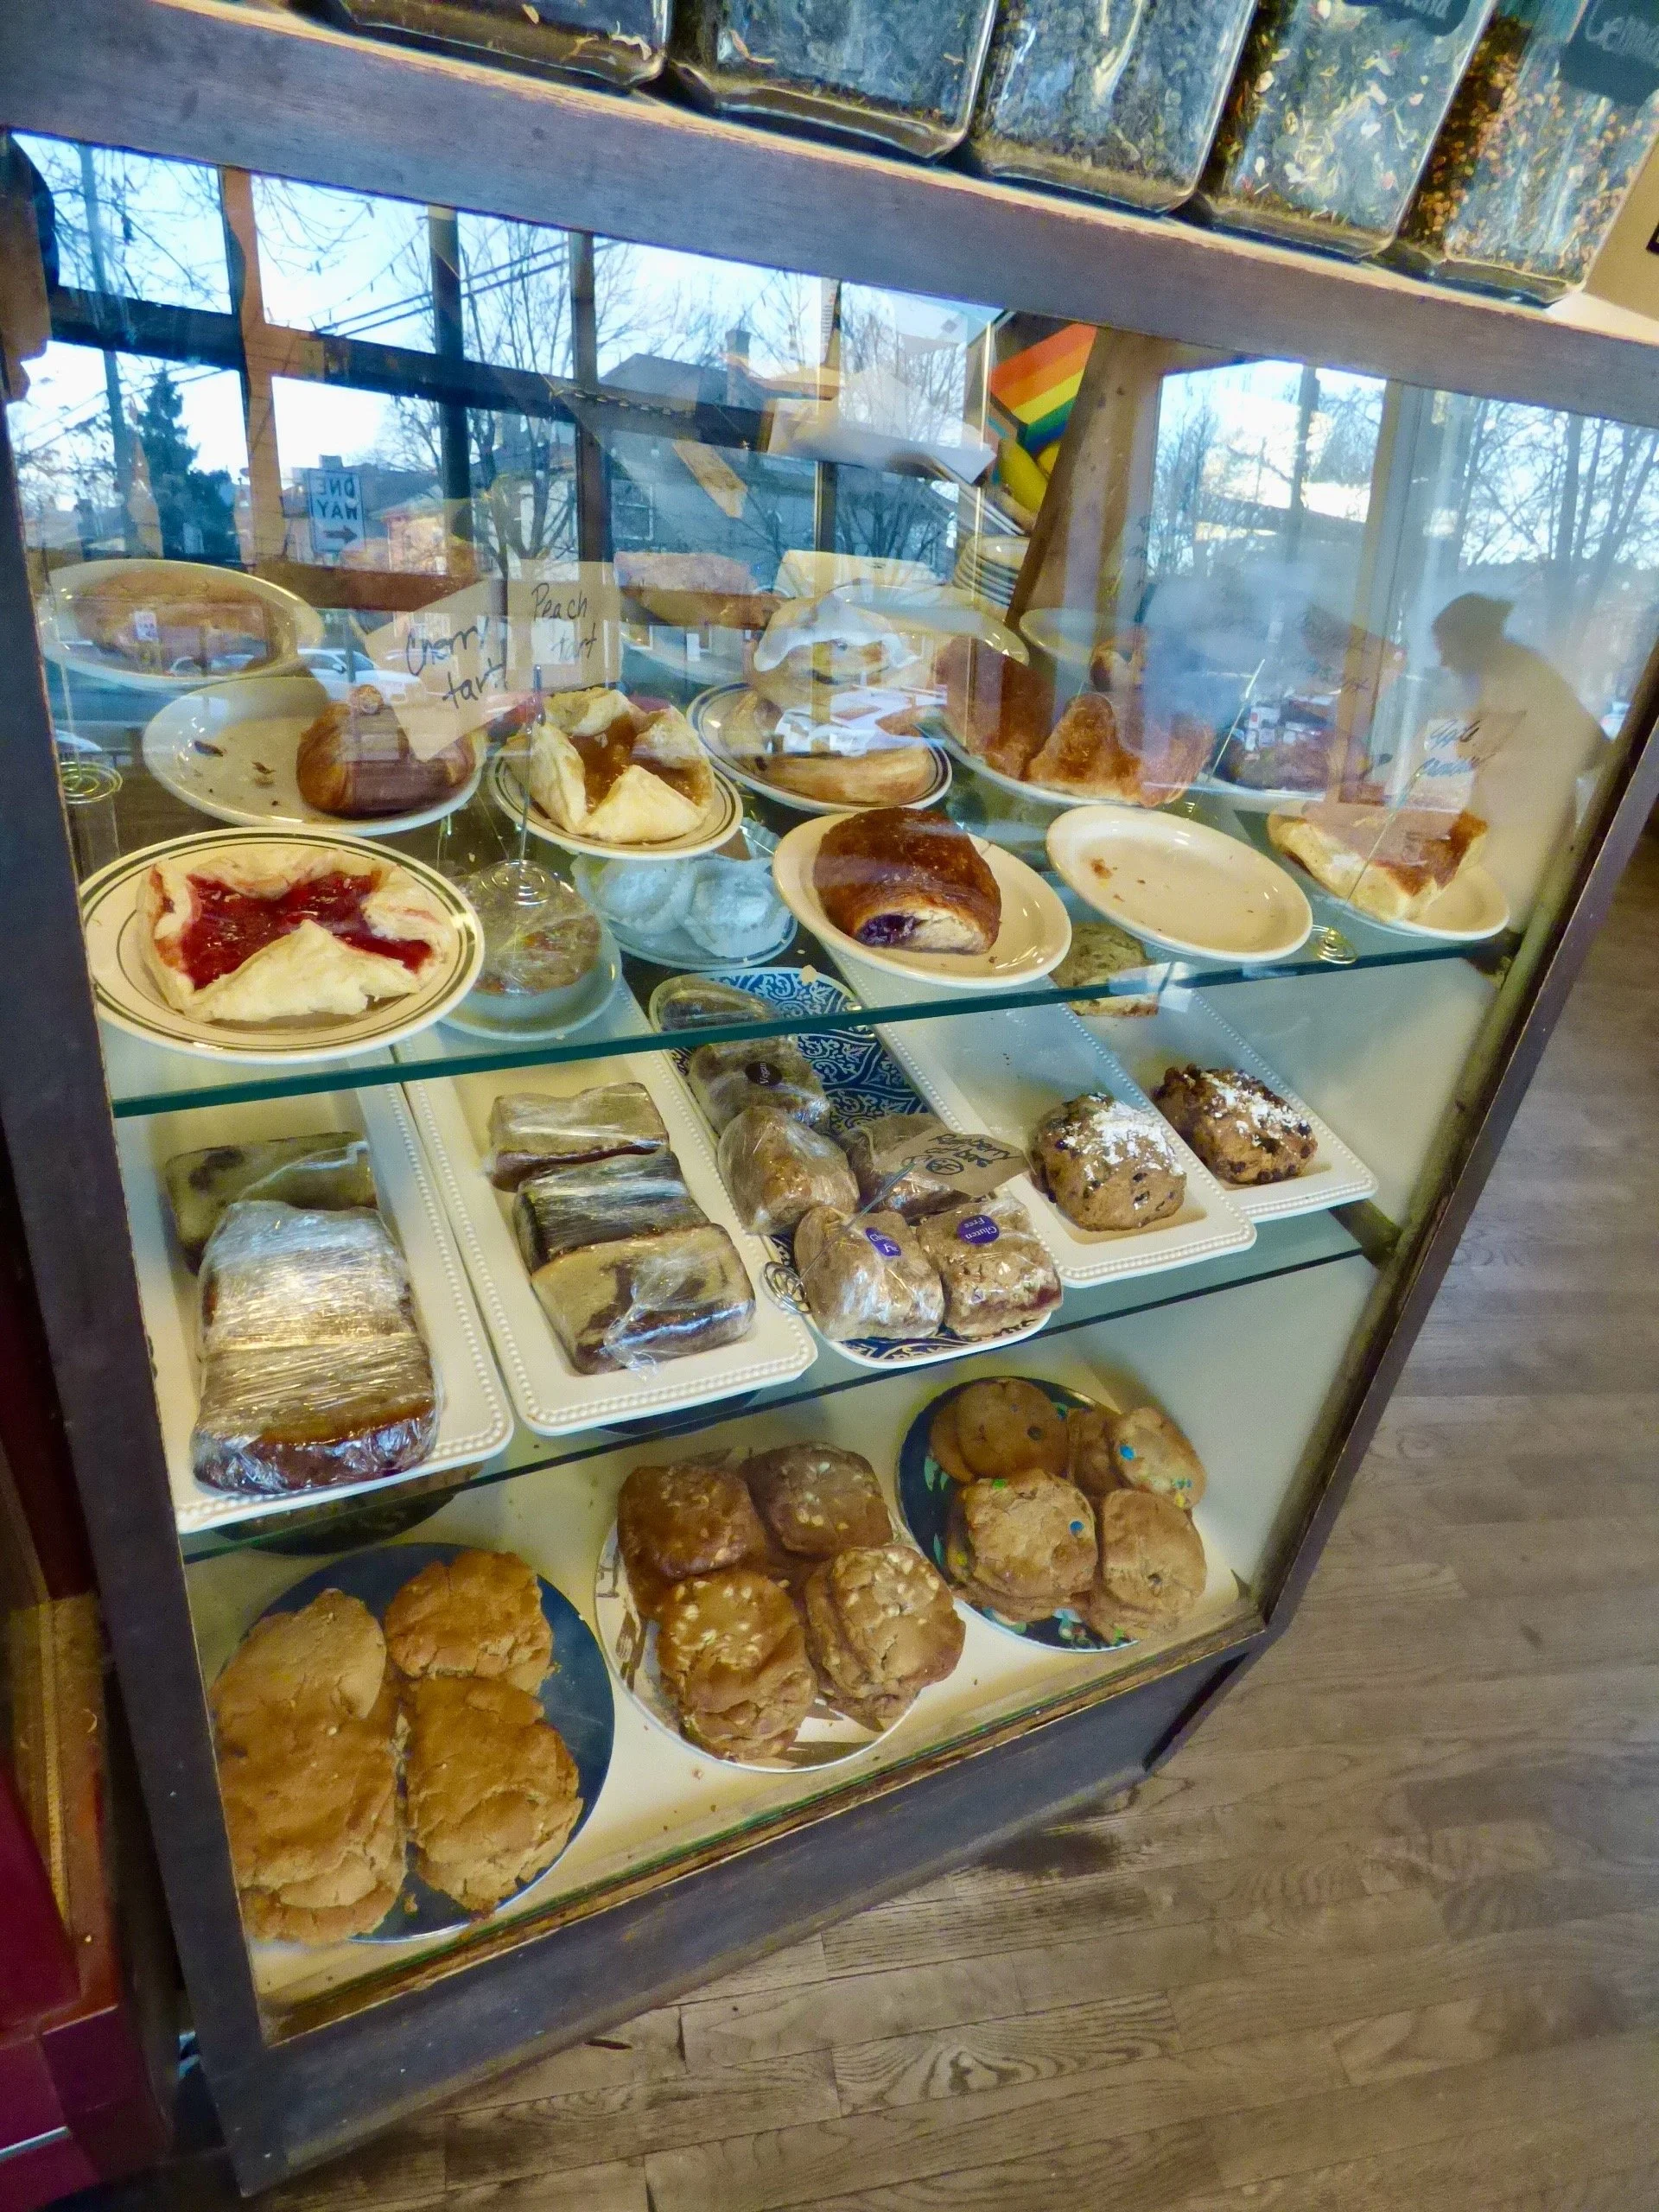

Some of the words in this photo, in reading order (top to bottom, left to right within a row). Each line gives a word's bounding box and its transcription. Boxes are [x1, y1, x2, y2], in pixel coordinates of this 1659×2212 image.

[531, 582, 588, 621] Peach
[550, 622, 597, 660] tart
[442, 657, 508, 709] tart
[963, 1217, 985, 1229] Free
[964, 1225, 997, 1241] Gluten
